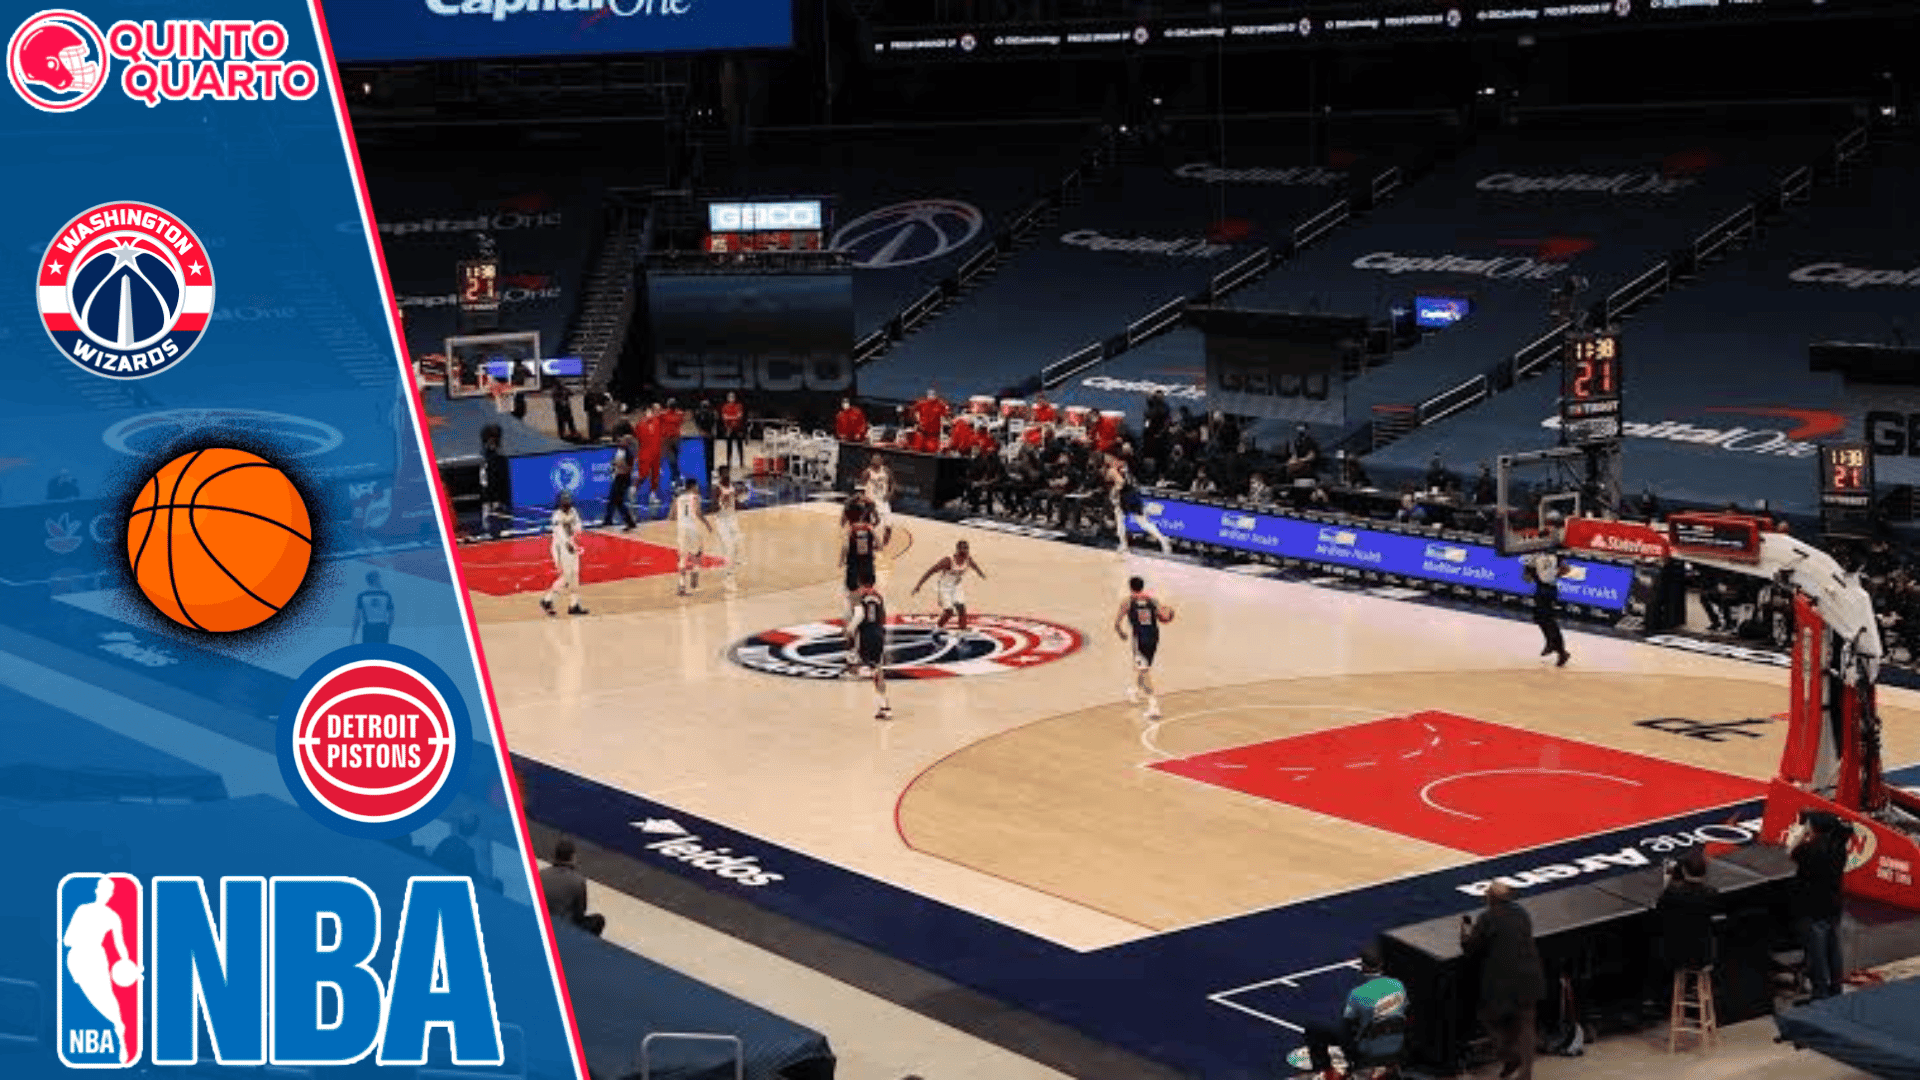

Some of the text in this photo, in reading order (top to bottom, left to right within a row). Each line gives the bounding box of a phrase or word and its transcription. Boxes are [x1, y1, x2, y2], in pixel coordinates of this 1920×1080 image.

[491, 212, 561, 230] One
[719, 206, 814, 228] GEICO
[466, 278, 495, 302] 21
[655, 352, 853, 391] GEICO
[1574, 360, 1612, 397] 21
[1834, 465, 1860, 487] 21
[1640, 824, 1753, 854] One
[645, 834, 785, 886] leidos
